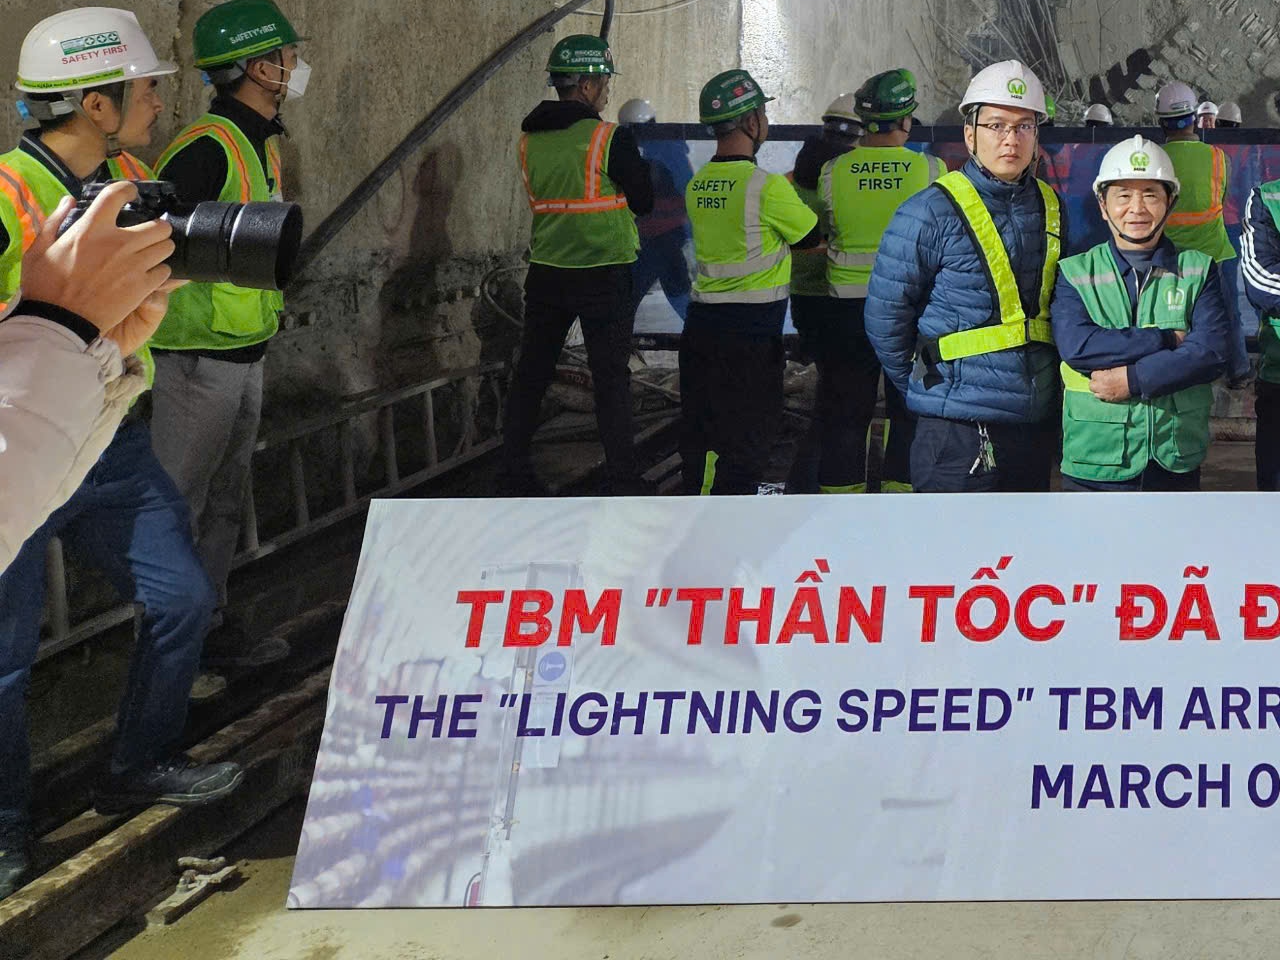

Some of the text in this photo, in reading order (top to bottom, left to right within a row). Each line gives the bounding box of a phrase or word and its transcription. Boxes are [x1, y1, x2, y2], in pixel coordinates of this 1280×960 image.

[229, 29, 259, 44] SAFETY
[61, 44, 129, 65] SAFETY FIRST
[850, 161, 912, 174] SAFETY
[692, 180, 737, 192] SAFETY
[858, 177, 903, 190] FIRST
[696, 197, 728, 209] FIRST
[457, 589, 622, 648] TBM
[645, 558, 886, 645] "THẦN
[909, 555, 1097, 643] TỐC"
[1115, 565, 1220, 640] ĐÃ
[374, 693, 483, 739] THE
[499, 690, 822, 738] "LIGHTNING
[836, 687, 1035, 734] SPEED"
[1049, 686, 1163, 731] TBM
[1030, 763, 1231, 810] MARCH
